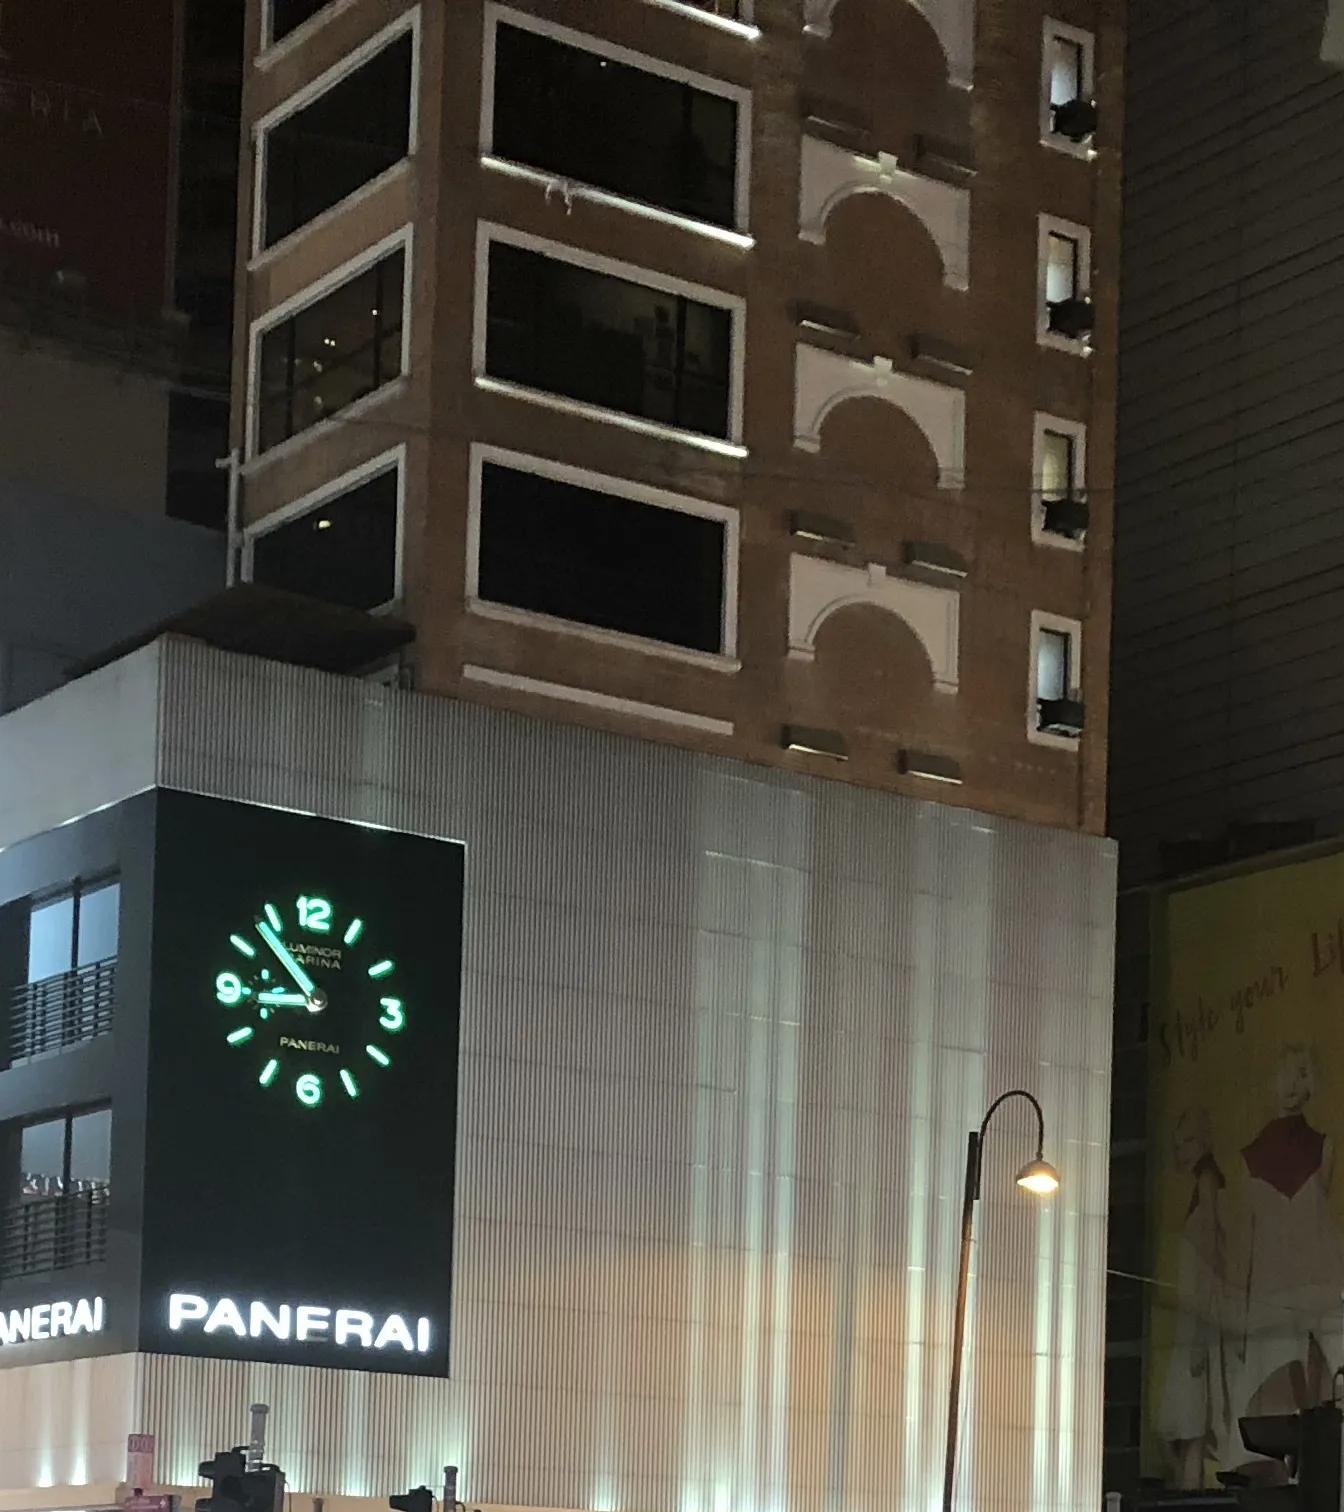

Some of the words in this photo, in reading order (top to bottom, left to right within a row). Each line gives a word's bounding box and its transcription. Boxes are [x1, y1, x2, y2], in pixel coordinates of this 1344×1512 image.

[297, 896, 331, 931] 12
[290, 953, 342, 970] ARINA
[217, 972, 242, 1003] 9
[379, 998, 404, 1031] 3
[279, 1036, 340, 1054] PANERAI
[296, 1074, 322, 1105] 6
